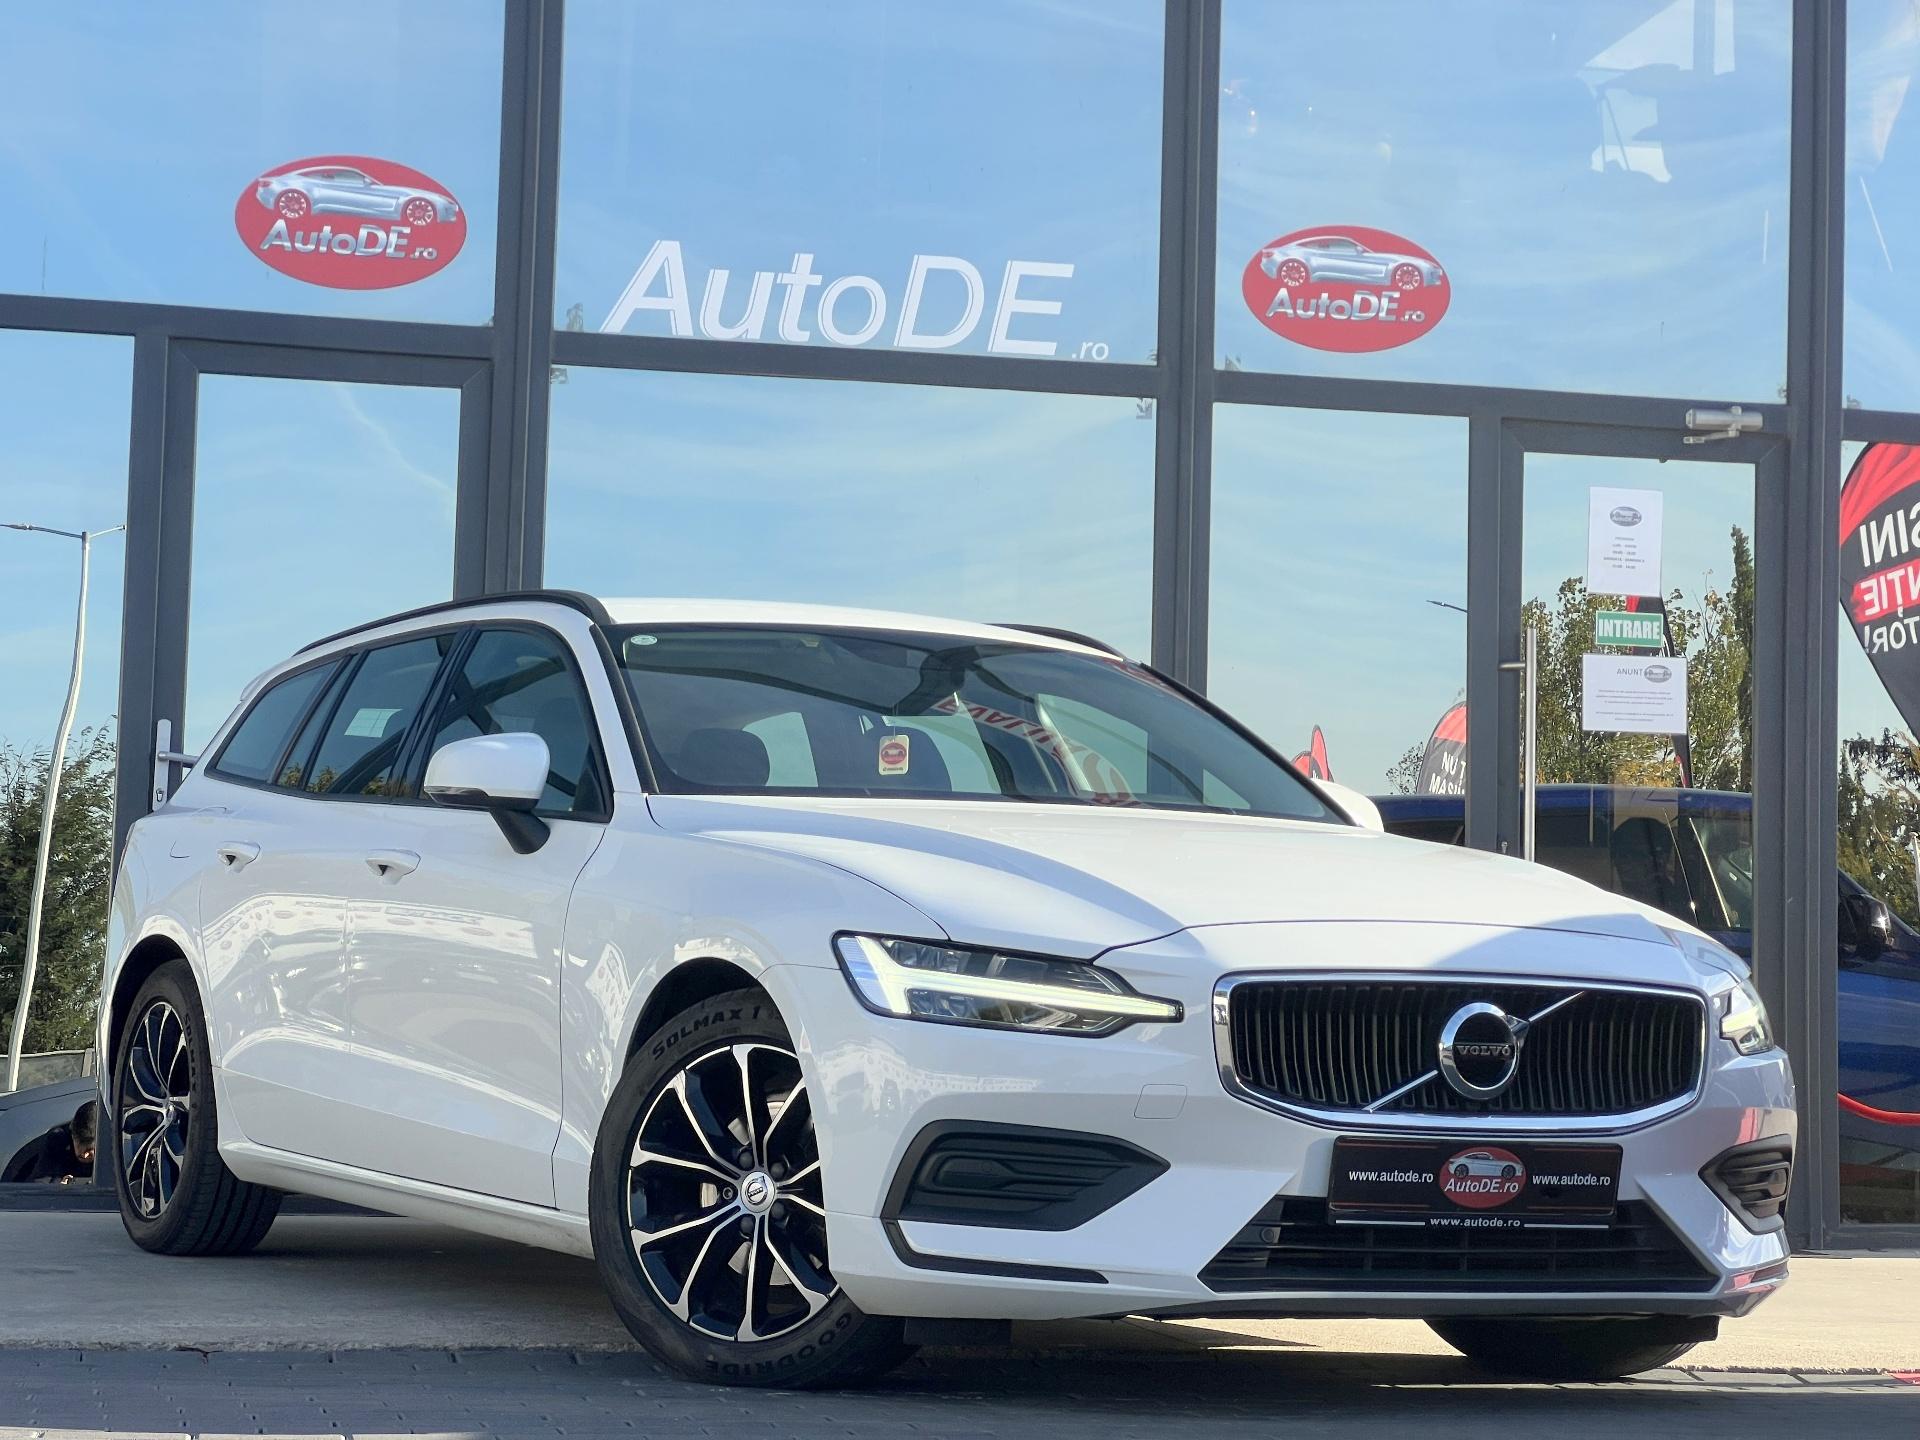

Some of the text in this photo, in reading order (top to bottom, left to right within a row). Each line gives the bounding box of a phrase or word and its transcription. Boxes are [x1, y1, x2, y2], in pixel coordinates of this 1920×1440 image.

[1599, 619, 1660, 639] INTRARE
[1441, 751, 1459, 776] NU
[652, 1008, 743, 1061] SOLMAX
[1456, 1045, 1511, 1056] VOLVO
[1349, 1170, 1434, 1183] www.autode.ro
[1532, 1173, 1611, 1187] www.autode.ro
[1444, 1178, 1519, 1194] AutoDE.ro
[1430, 1217, 1521, 1228] www.autode.ro
[705, 1312, 851, 1376] GOODRIDE
